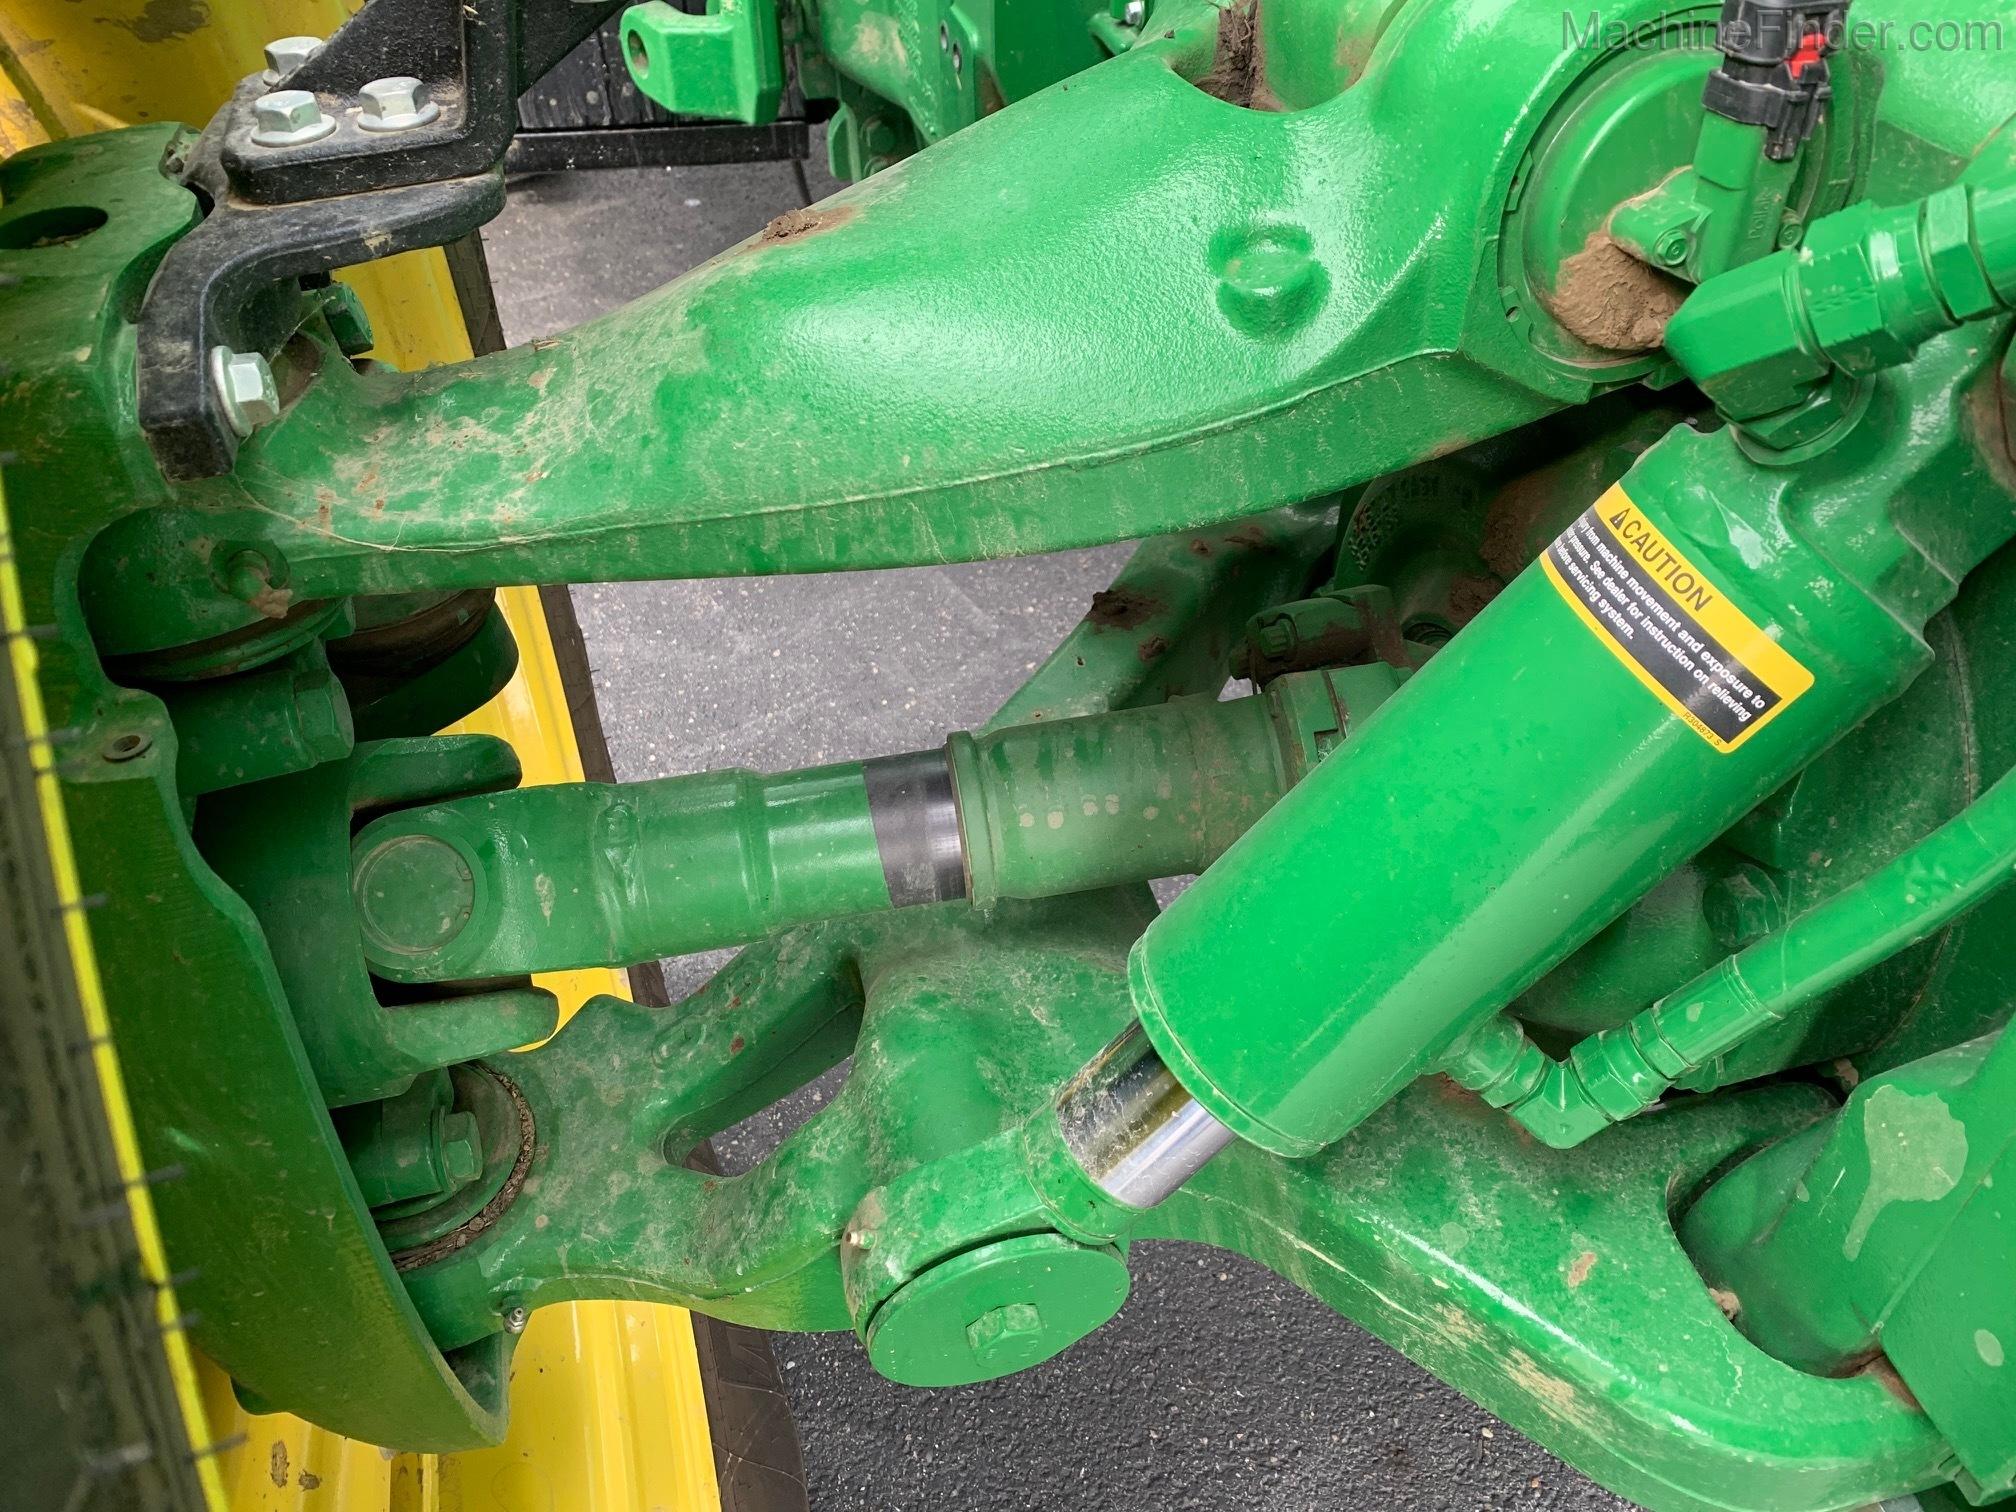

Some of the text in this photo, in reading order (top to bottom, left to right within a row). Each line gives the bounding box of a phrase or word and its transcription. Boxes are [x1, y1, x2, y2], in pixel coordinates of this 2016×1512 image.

[1748, 186, 1773, 240] Pollak
[1556, 542, 1635, 640] before servicing system.
[1622, 519, 1713, 612] CAUTION
[1567, 534, 1752, 722] pressure. See dealer for instruction on relieving
[1585, 526, 1601, 546] from
[1596, 542, 1629, 579] machine
[1626, 577, 1682, 632] movement
[1677, 629, 1705, 653] and
[1700, 651, 1753, 699] exposure
[1751, 694, 1766, 709] to
[1682, 711, 1714, 740] R304873
